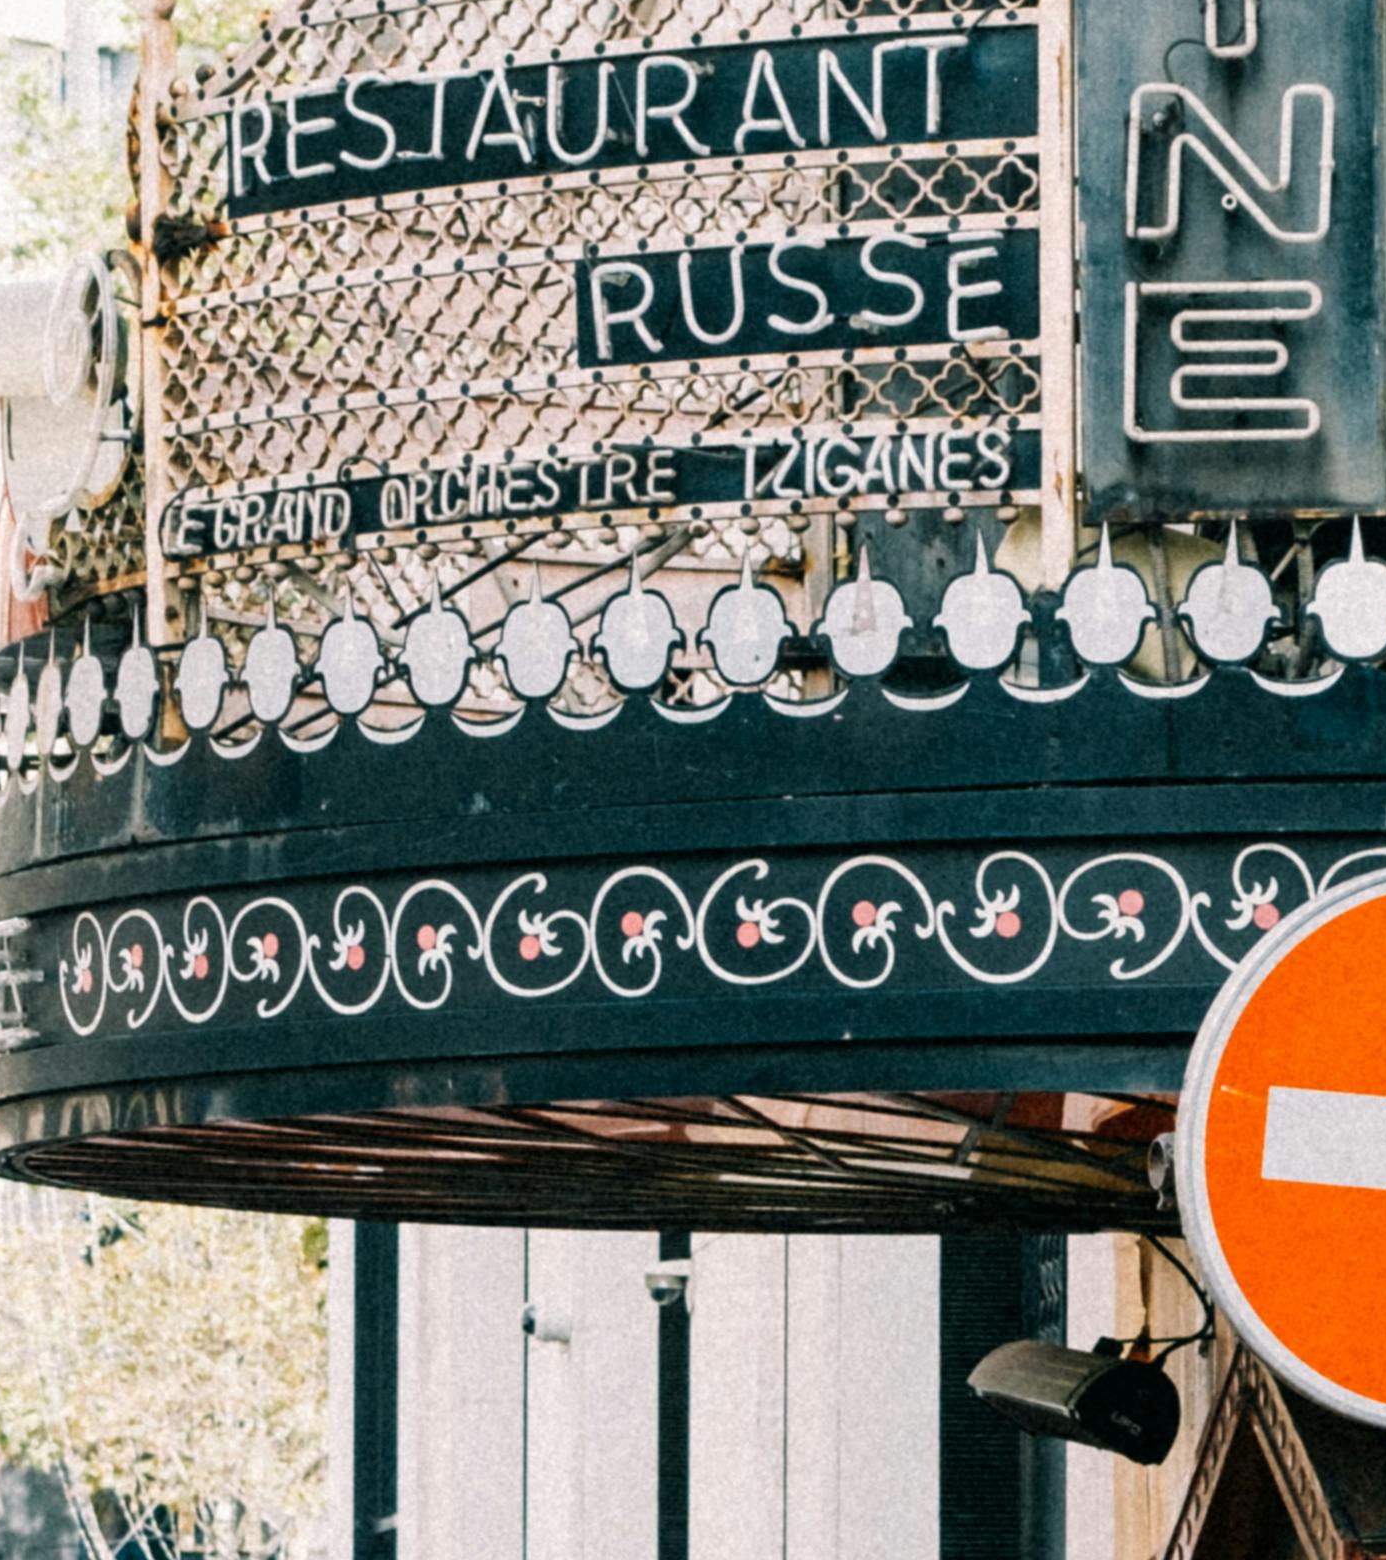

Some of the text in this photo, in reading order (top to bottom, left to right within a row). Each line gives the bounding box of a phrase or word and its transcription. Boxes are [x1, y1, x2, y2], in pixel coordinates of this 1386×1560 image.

[226, 34, 969, 198] RESTAURANT
[588, 230, 1010, 359] RUSSE
[213, 486, 352, 548] GRAND
[380, 449, 678, 529] ORCHESTRE
[737, 427, 1012, 500] TZIGANES
